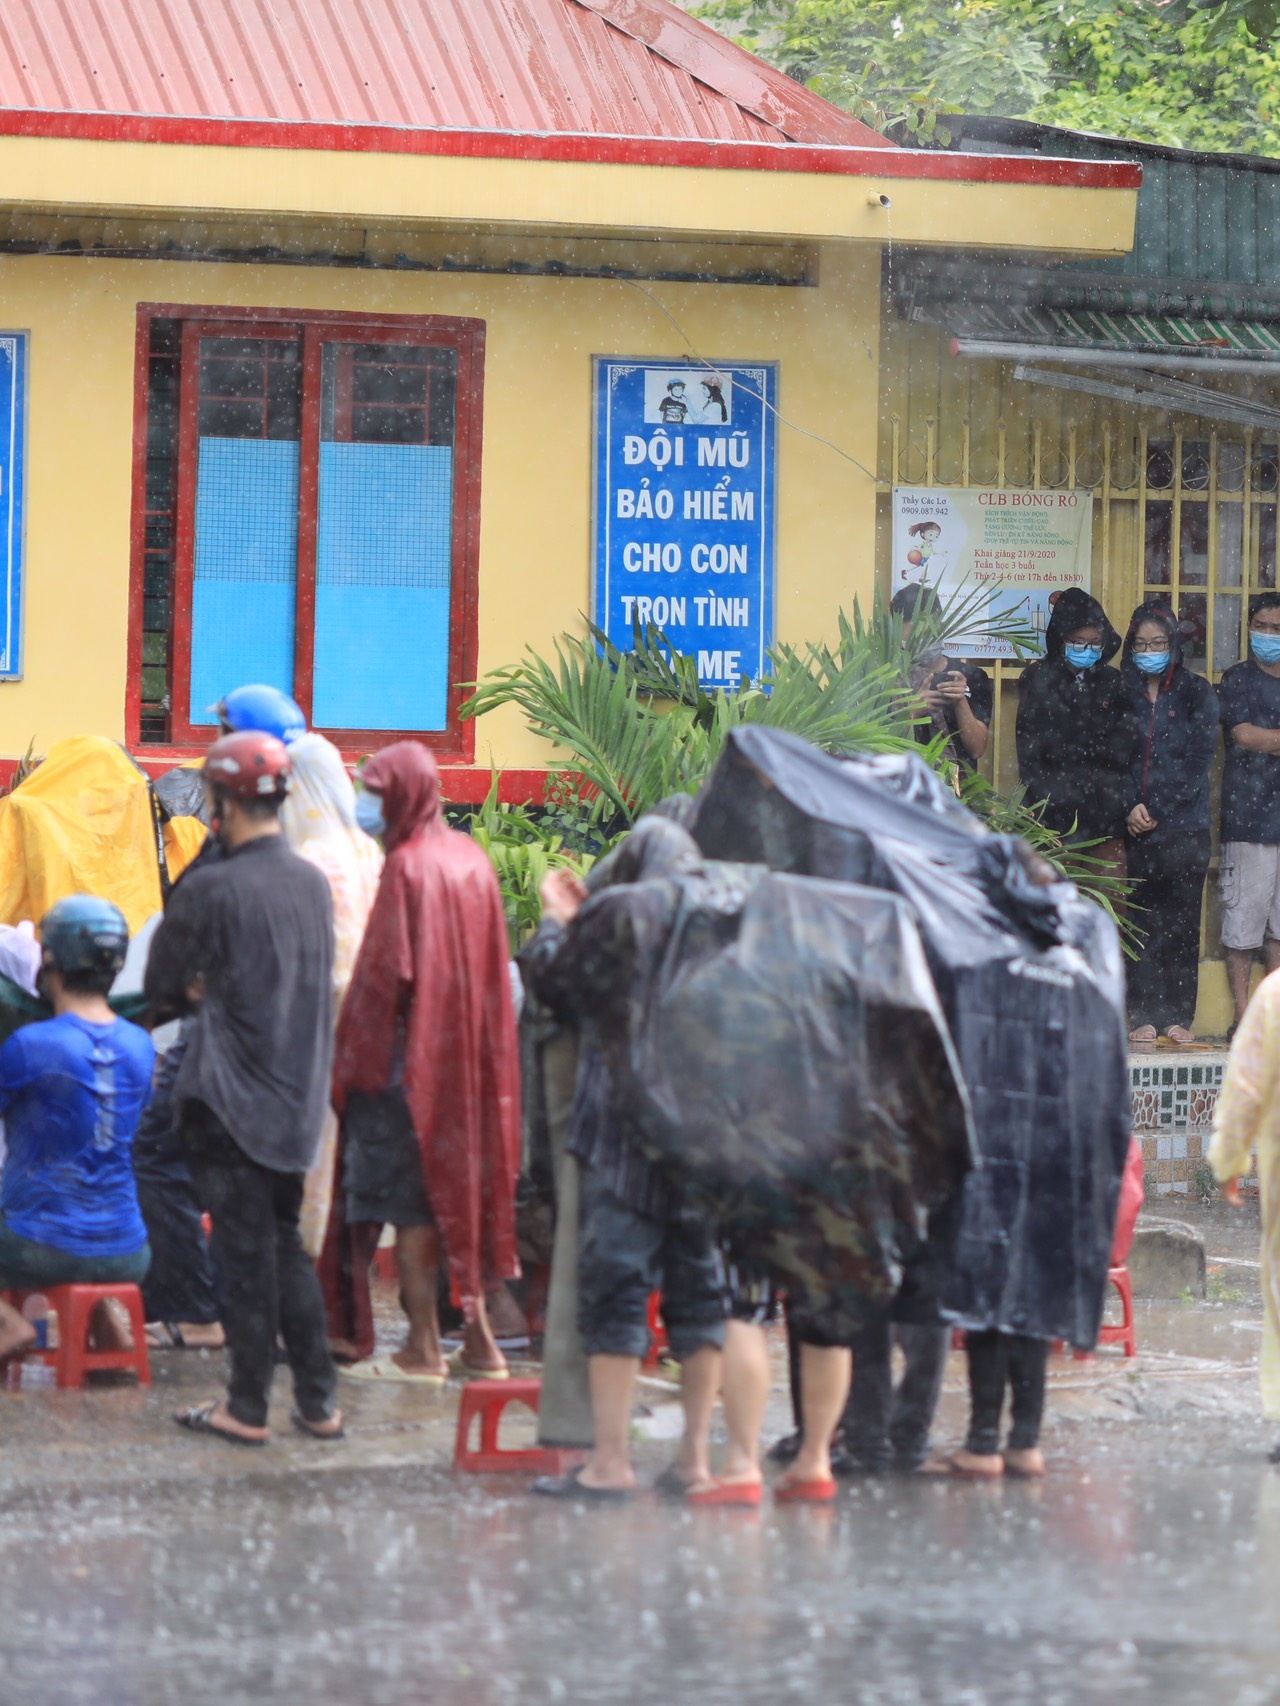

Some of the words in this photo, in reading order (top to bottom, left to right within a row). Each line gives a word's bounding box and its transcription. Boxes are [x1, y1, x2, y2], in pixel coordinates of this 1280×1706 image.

[622, 428, 684, 472] ĐỘI
[697, 430, 750, 468] MŨ
[616, 477, 674, 520] BẢO
[683, 475, 754, 521] HIỂM
[921, 496, 935, 505] Các
[978, 493, 1007, 506] CLB
[1011, 491, 1054, 507] BÓNG
[901, 507, 949, 516] 0909.087.942
[622, 542, 682, 573] CHO
[690, 543, 748, 574] CON
[974, 549, 993, 558] Khai
[994, 549, 1016, 559] giảng
[1018, 550, 1056, 559] 21/9/2020
[974, 559, 994, 569] Tuần
[995, 561, 1009, 570] học
[1011, 561, 1016, 569] 3
[1018, 560, 1035, 570] buổi
[1028, 573, 1042, 581] 17h
[620, 595, 687, 632] TRỌN
[693, 589, 749, 627] TÌNH
[697, 650, 741, 686] MẸ
